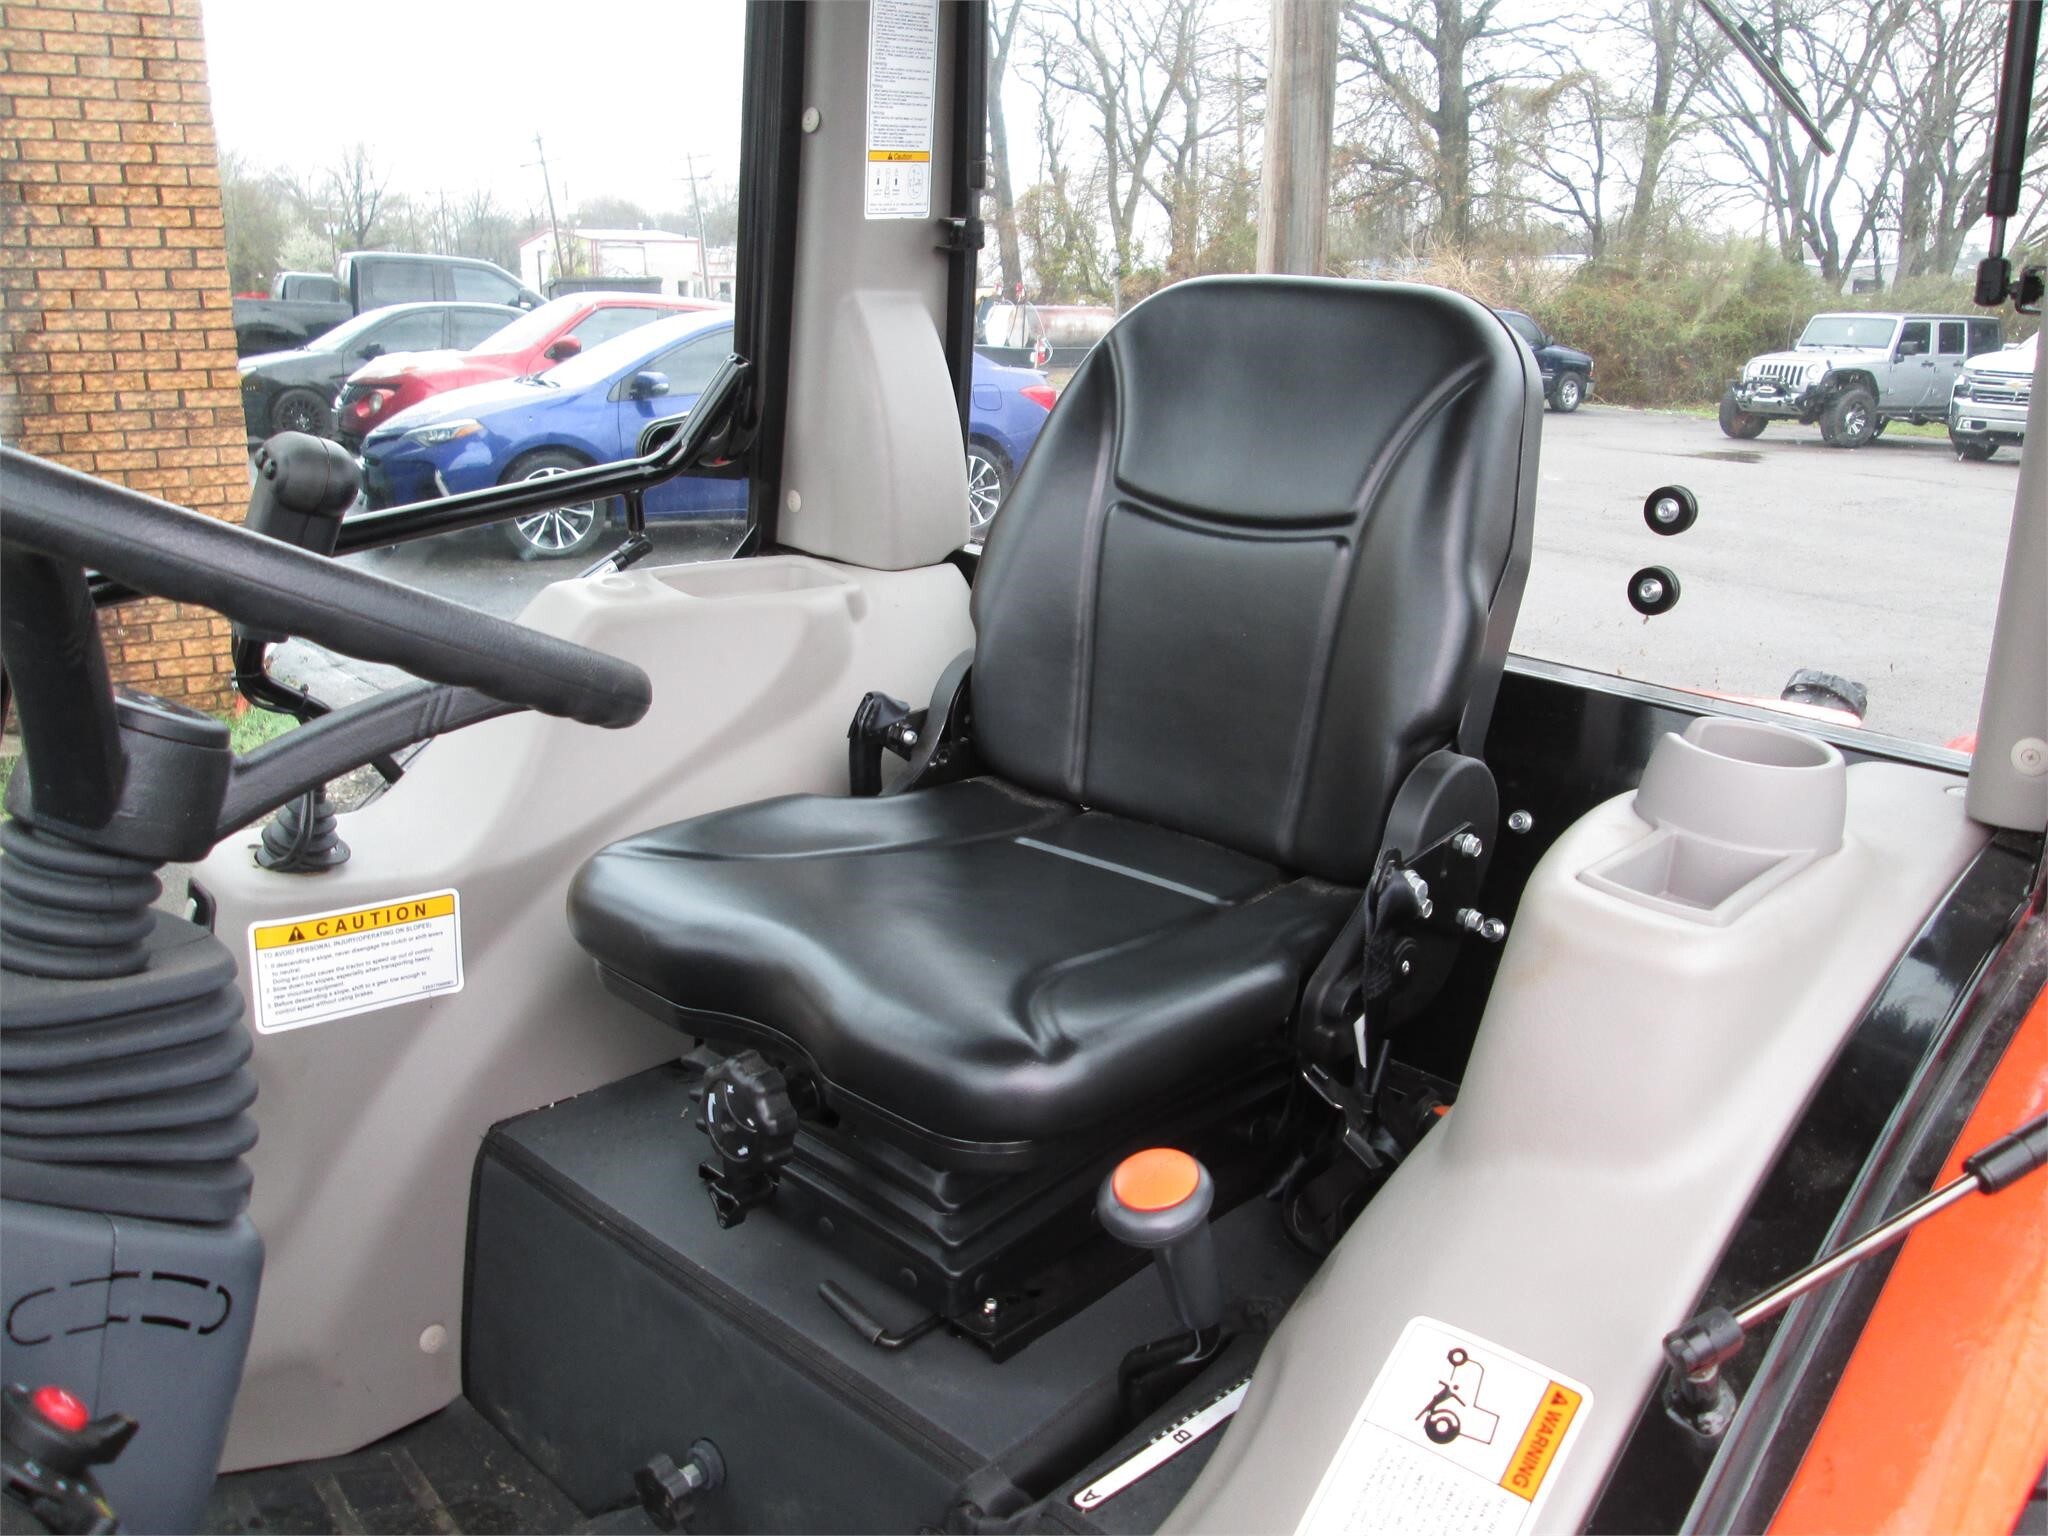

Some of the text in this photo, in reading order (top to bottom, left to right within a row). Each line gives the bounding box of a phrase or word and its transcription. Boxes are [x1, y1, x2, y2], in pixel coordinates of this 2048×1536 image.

[315, 903, 426, 936] CAUTION
[275, 949, 295, 957] AVOID
[296, 942, 331, 954] PERSONAL
[276, 957, 310, 970] descending
[352, 944, 380, 954] disengage
[273, 977, 290, 986] Doing
[346, 962, 364, 970] tractor
[373, 957, 389, 966] speed
[336, 969, 364, 981] especially
[381, 959, 413, 971] transporting
[274, 999, 293, 1008] Before
[295, 992, 328, 1005] descending
[400, 971, 420, 981] enough
[287, 988, 312, 997] mounted
[275, 1006, 296, 1016] control
[297, 1002, 314, 1012] speed
[316, 997, 336, 1007] without
[338, 994, 354, 1003] using
[1173, 1429, 1193, 1444] B
[1511, 1410, 1563, 1489] WARNING
[1082, 1489, 1101, 1503] A
